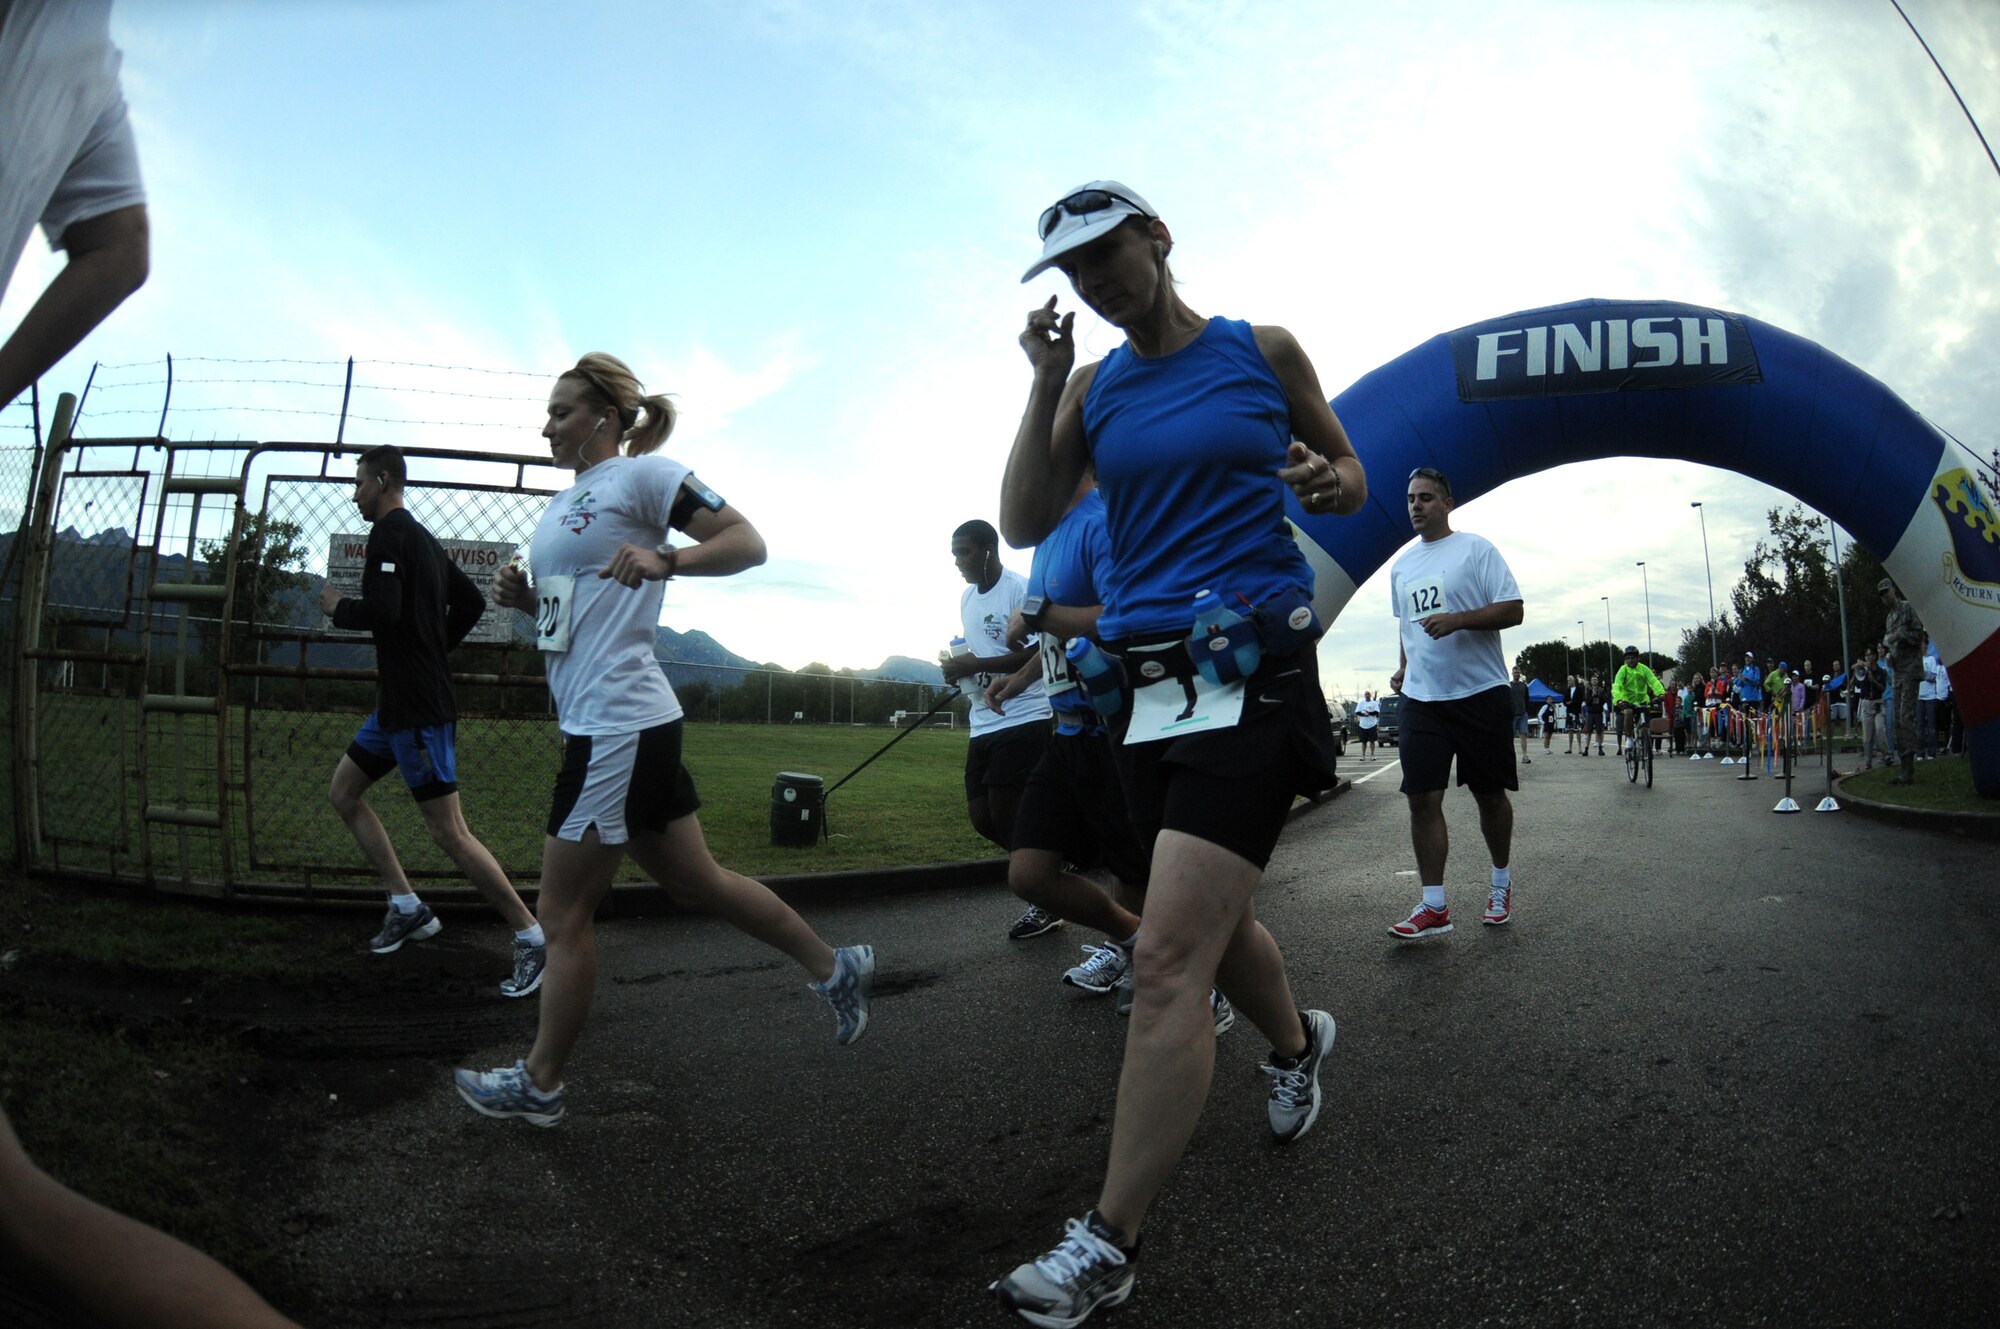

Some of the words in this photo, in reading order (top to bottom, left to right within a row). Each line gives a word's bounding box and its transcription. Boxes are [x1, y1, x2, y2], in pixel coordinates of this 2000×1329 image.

[1476, 317, 1728, 381] FINISH
[331, 570, 361, 579] MILITARY
[1411, 585, 1442, 614] 122
[1952, 576, 1993, 601] RETURN
